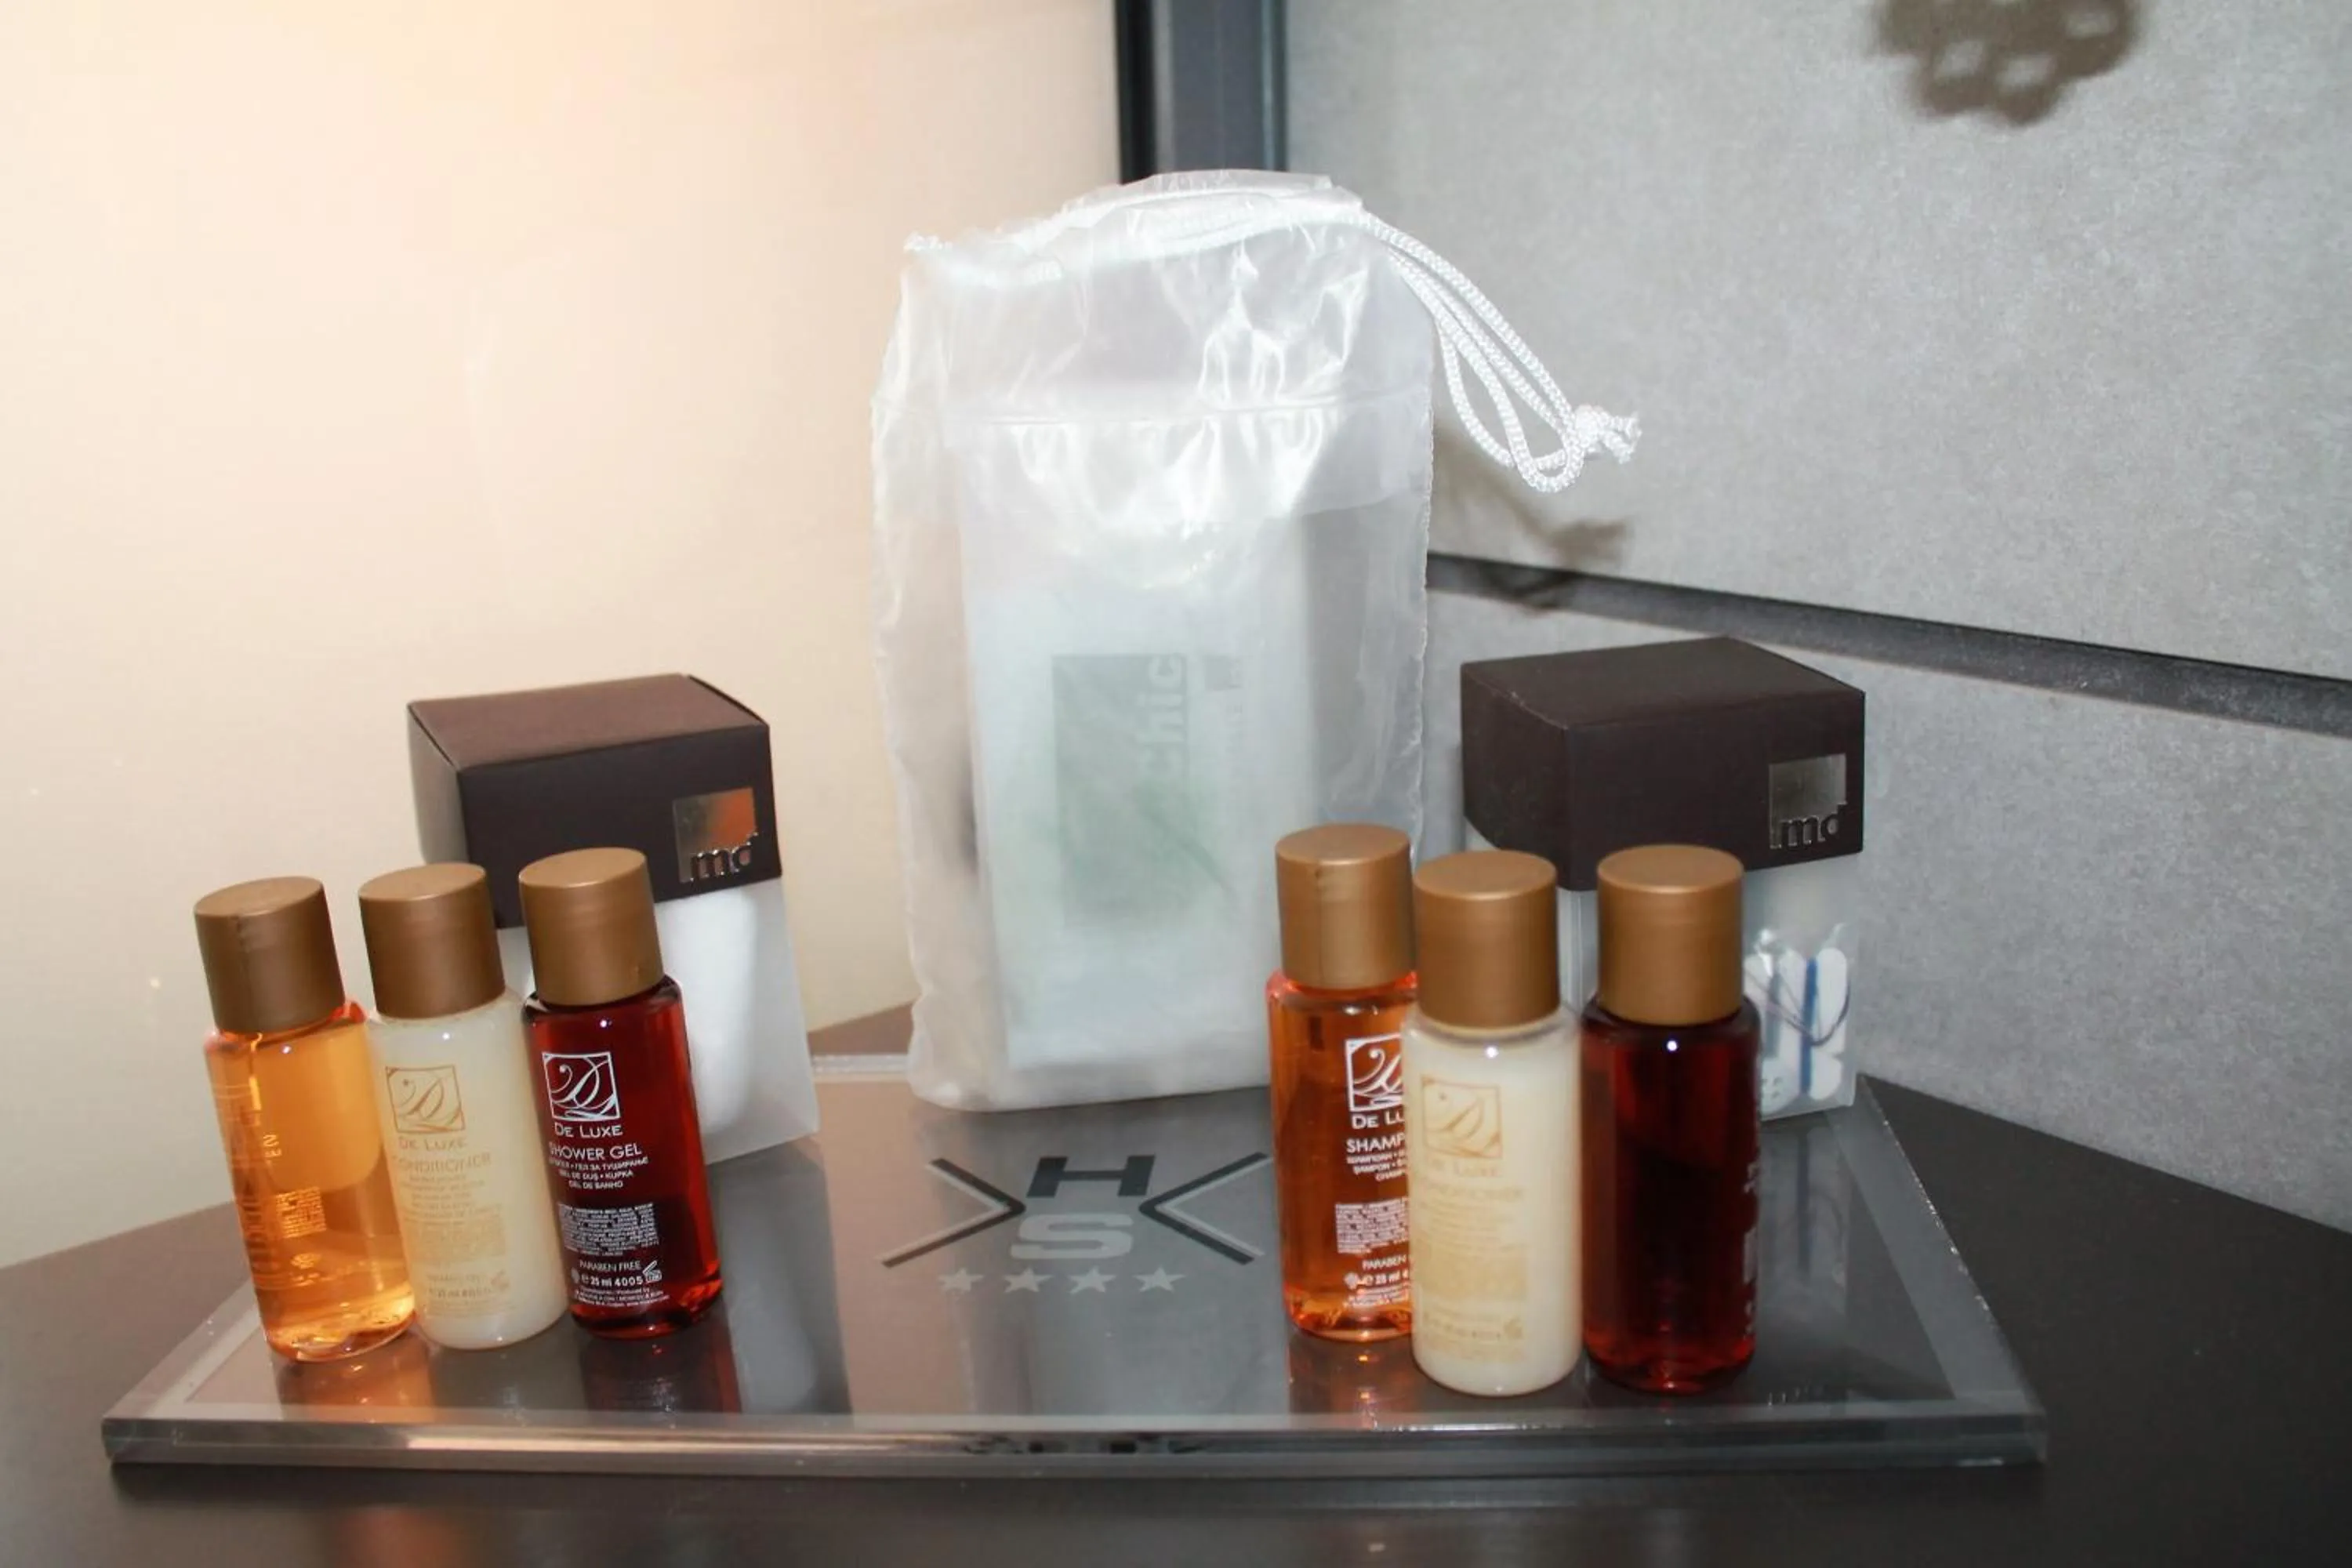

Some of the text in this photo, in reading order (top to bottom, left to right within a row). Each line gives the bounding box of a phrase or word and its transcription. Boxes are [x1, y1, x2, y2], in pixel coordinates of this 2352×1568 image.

[554, 1121, 623, 1139] DE LUXE
[1352, 1114, 1379, 1130] DE
[1346, 1132, 1406, 1154] SHAMP
[609, 1143, 642, 1160] GEL
[619, 1260, 642, 1272] FREE
[615, 1275, 644, 1287] 4005
